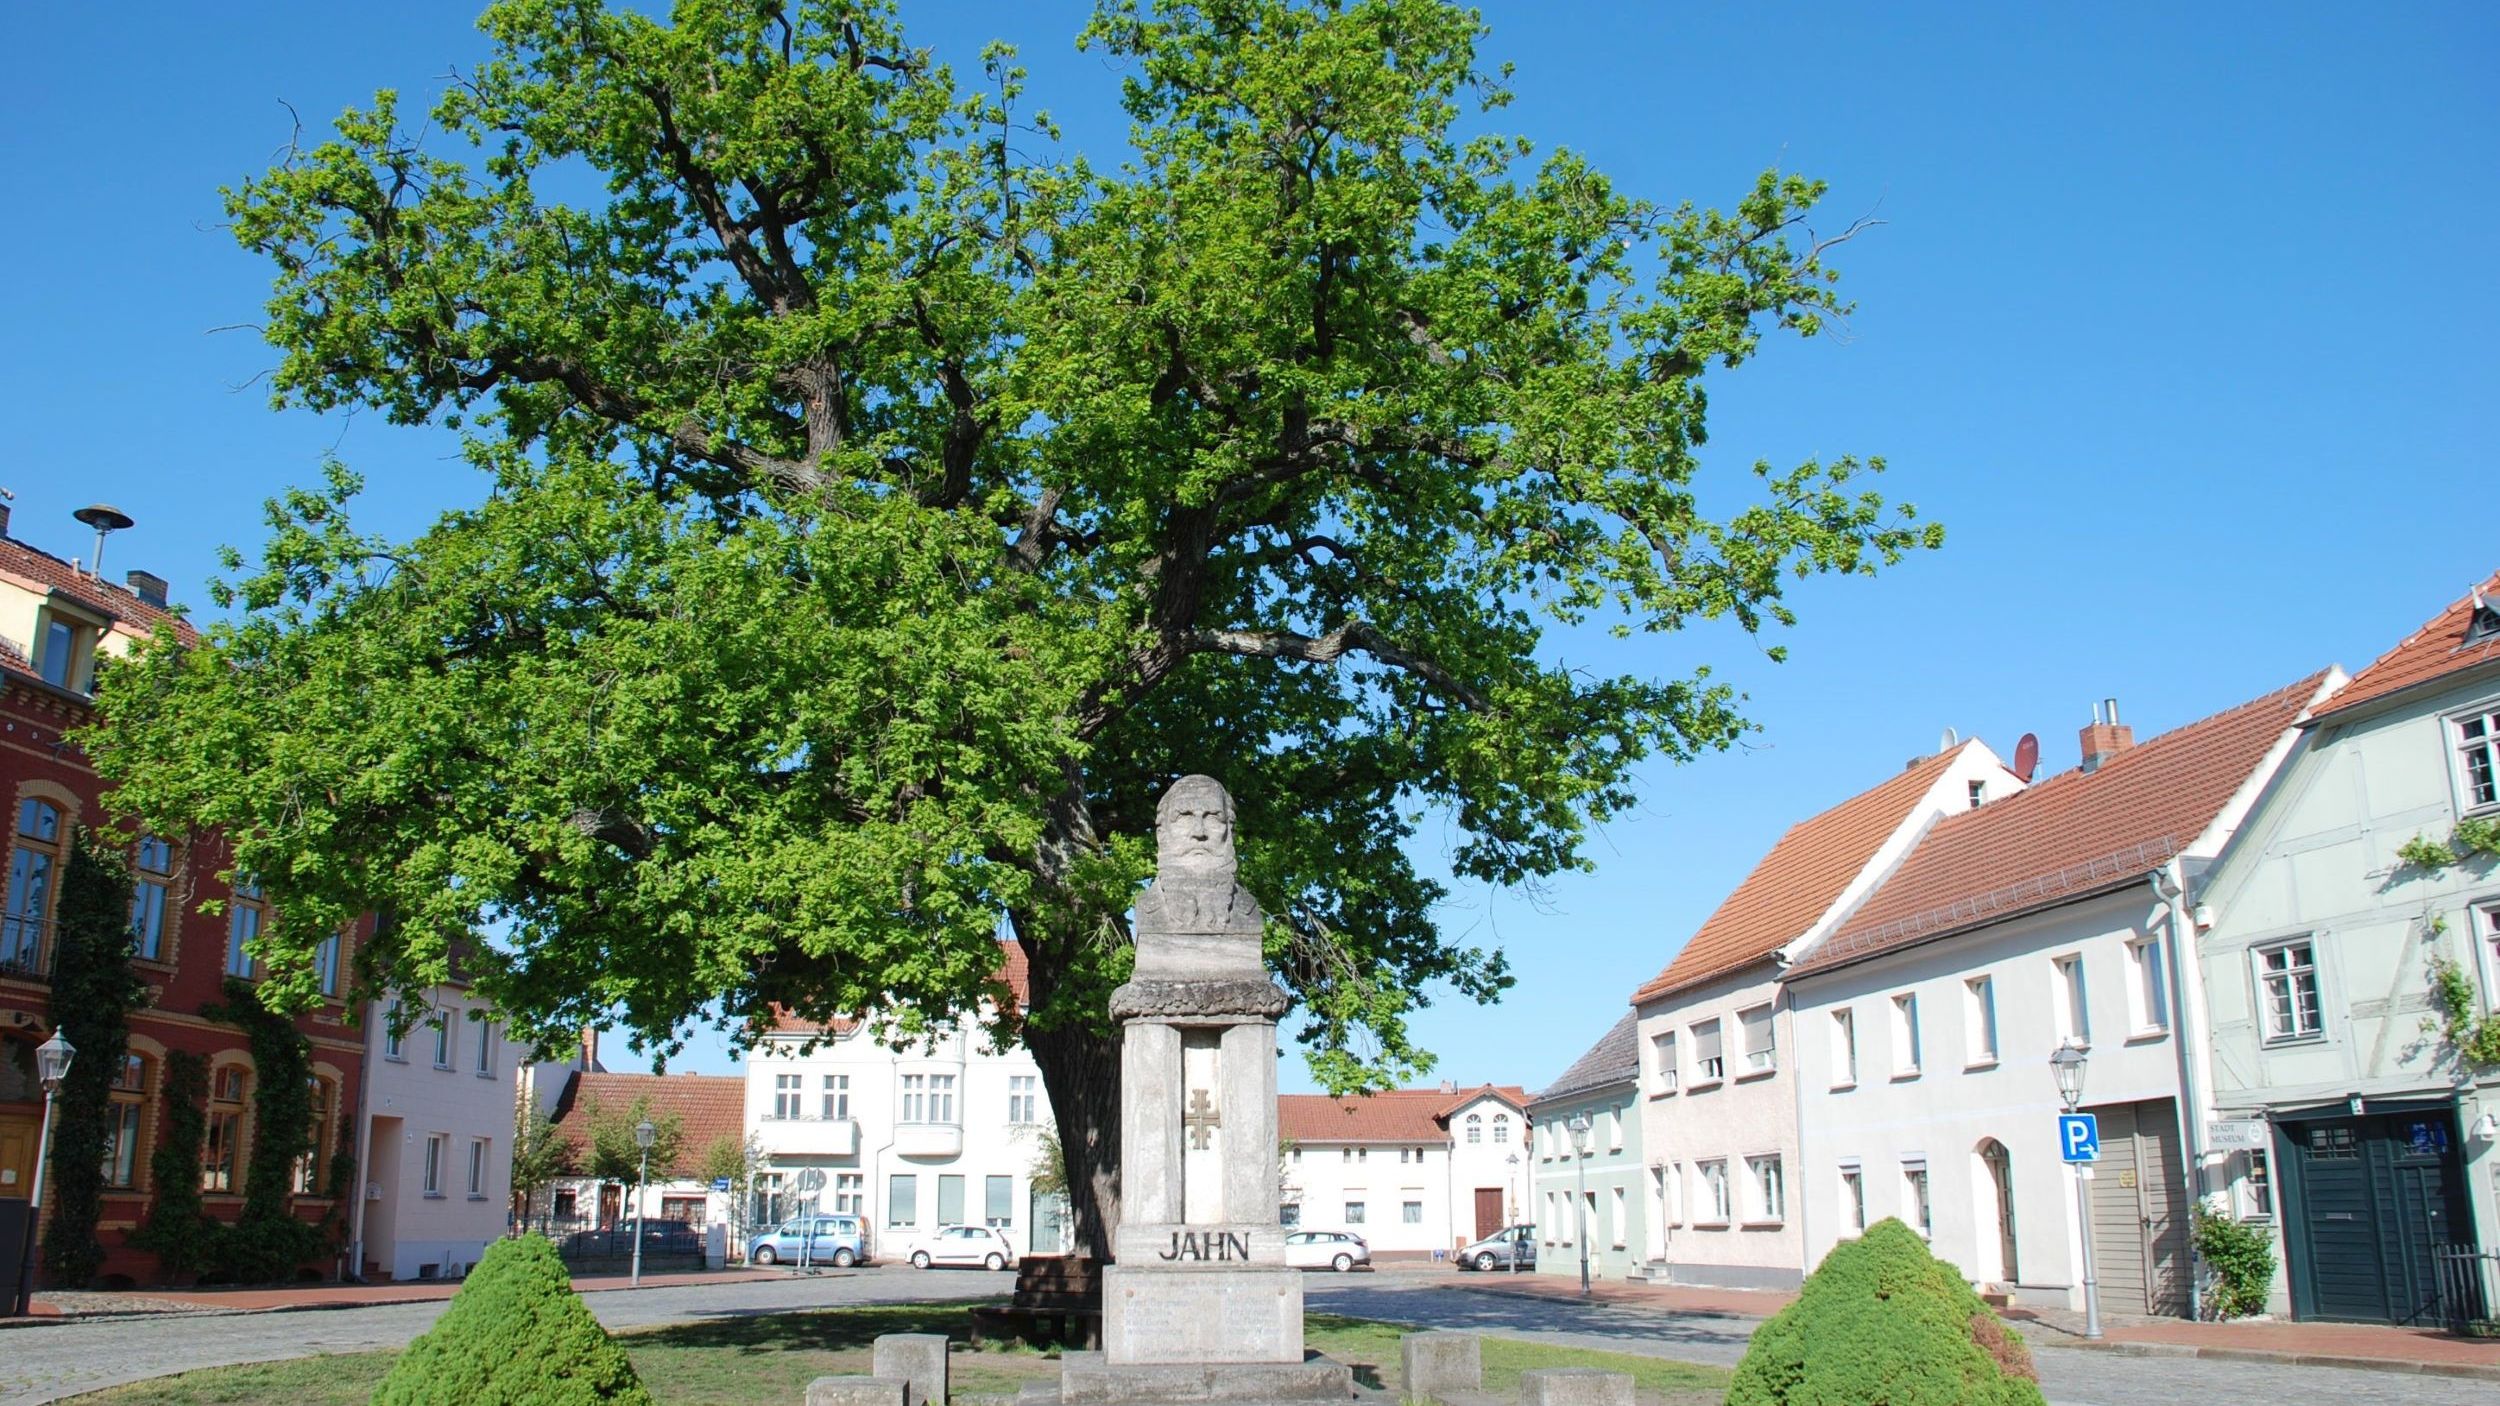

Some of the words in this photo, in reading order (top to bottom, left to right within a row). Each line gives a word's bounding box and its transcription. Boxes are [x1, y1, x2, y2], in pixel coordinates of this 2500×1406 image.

[2209, 1124, 2235, 1132] STADT
[2067, 1121, 2089, 1155] P
[2211, 1135, 2245, 1143] MUSEUM
[1159, 1231, 1250, 1261] JAHN
